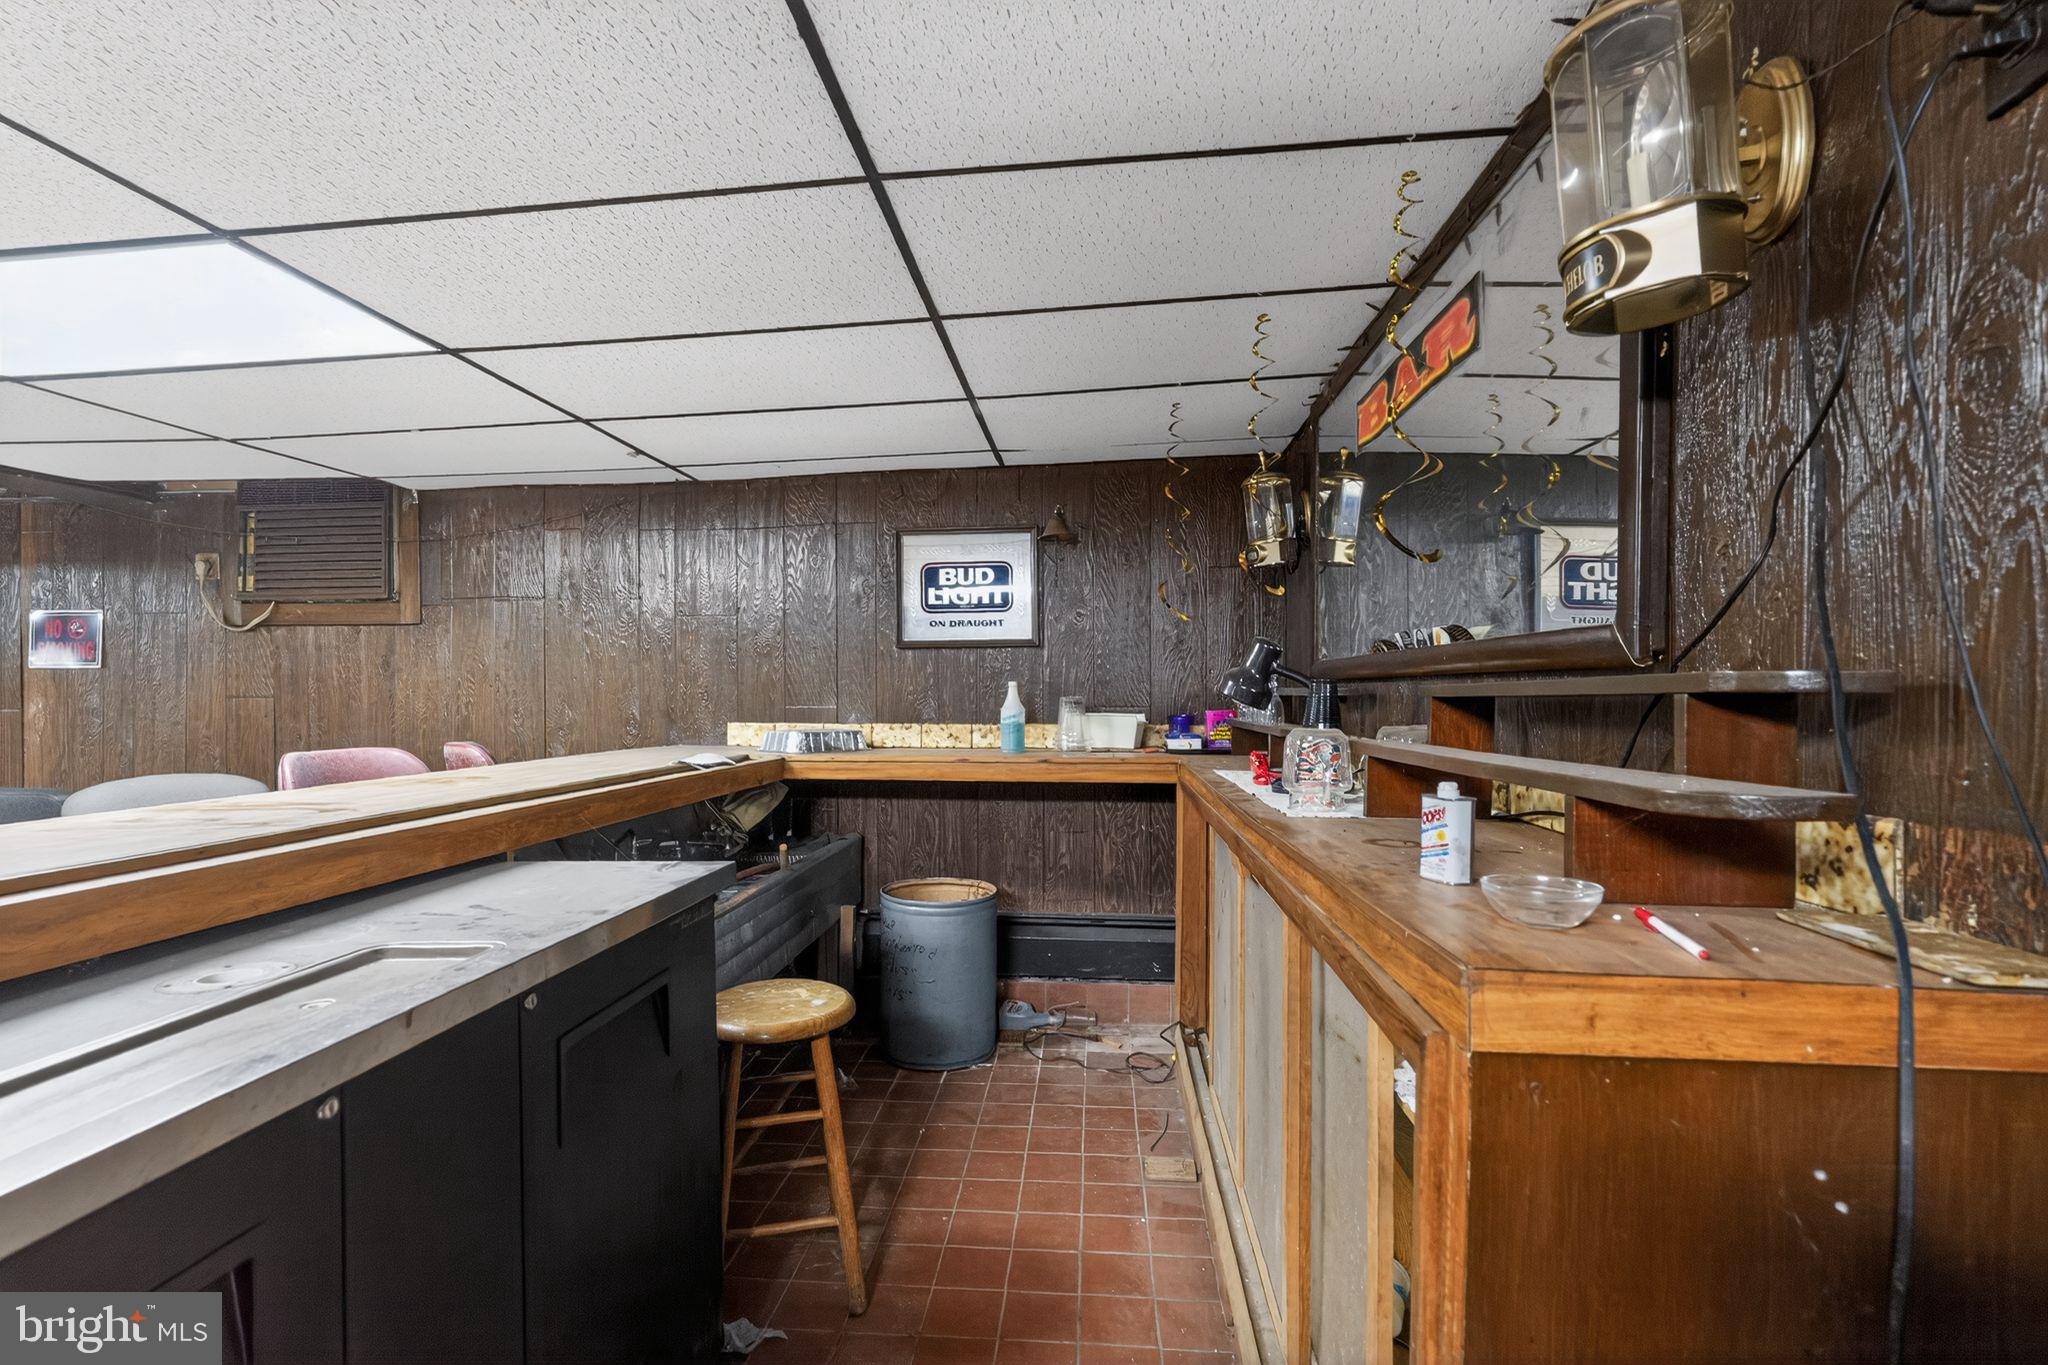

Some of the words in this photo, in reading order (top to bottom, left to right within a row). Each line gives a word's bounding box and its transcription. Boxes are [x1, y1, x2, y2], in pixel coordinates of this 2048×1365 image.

[1358, 298, 1475, 446] BAR
[939, 567, 995, 586] BUD
[928, 585, 1006, 605] LIGHT
[45, 619, 62, 639] NO
[929, 619, 946, 627] ON
[949, 619, 1004, 627] DRAUGHT
[36, 641, 95, 660] SMOKING
